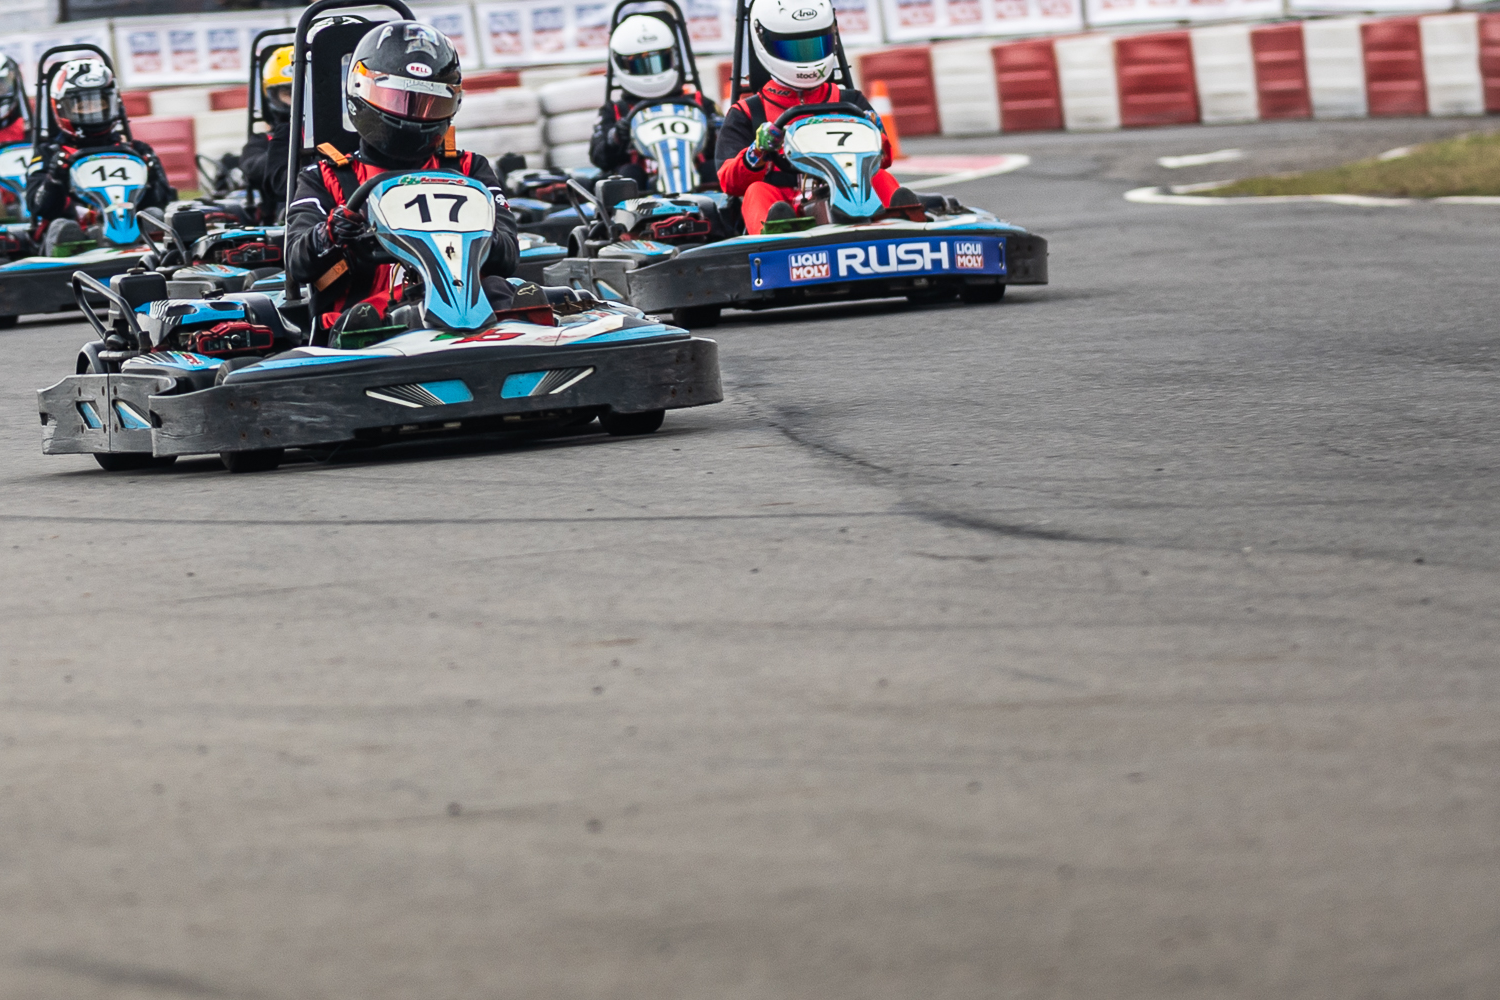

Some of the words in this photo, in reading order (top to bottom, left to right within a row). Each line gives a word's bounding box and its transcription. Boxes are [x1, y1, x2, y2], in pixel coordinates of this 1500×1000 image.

[409, 65, 429, 74] BELL
[796, 66, 827, 80] stockX
[651, 121, 690, 135] 10
[826, 131, 853, 147] 7
[91, 165, 132, 182] 14
[404, 193, 468, 223] 17
[956, 243, 982, 255] LIQUI
[791, 252, 827, 266] LIQUI
[837, 241, 949, 277] RUSH
[957, 255, 984, 268] MOLY
[792, 265, 829, 279] MOLY
